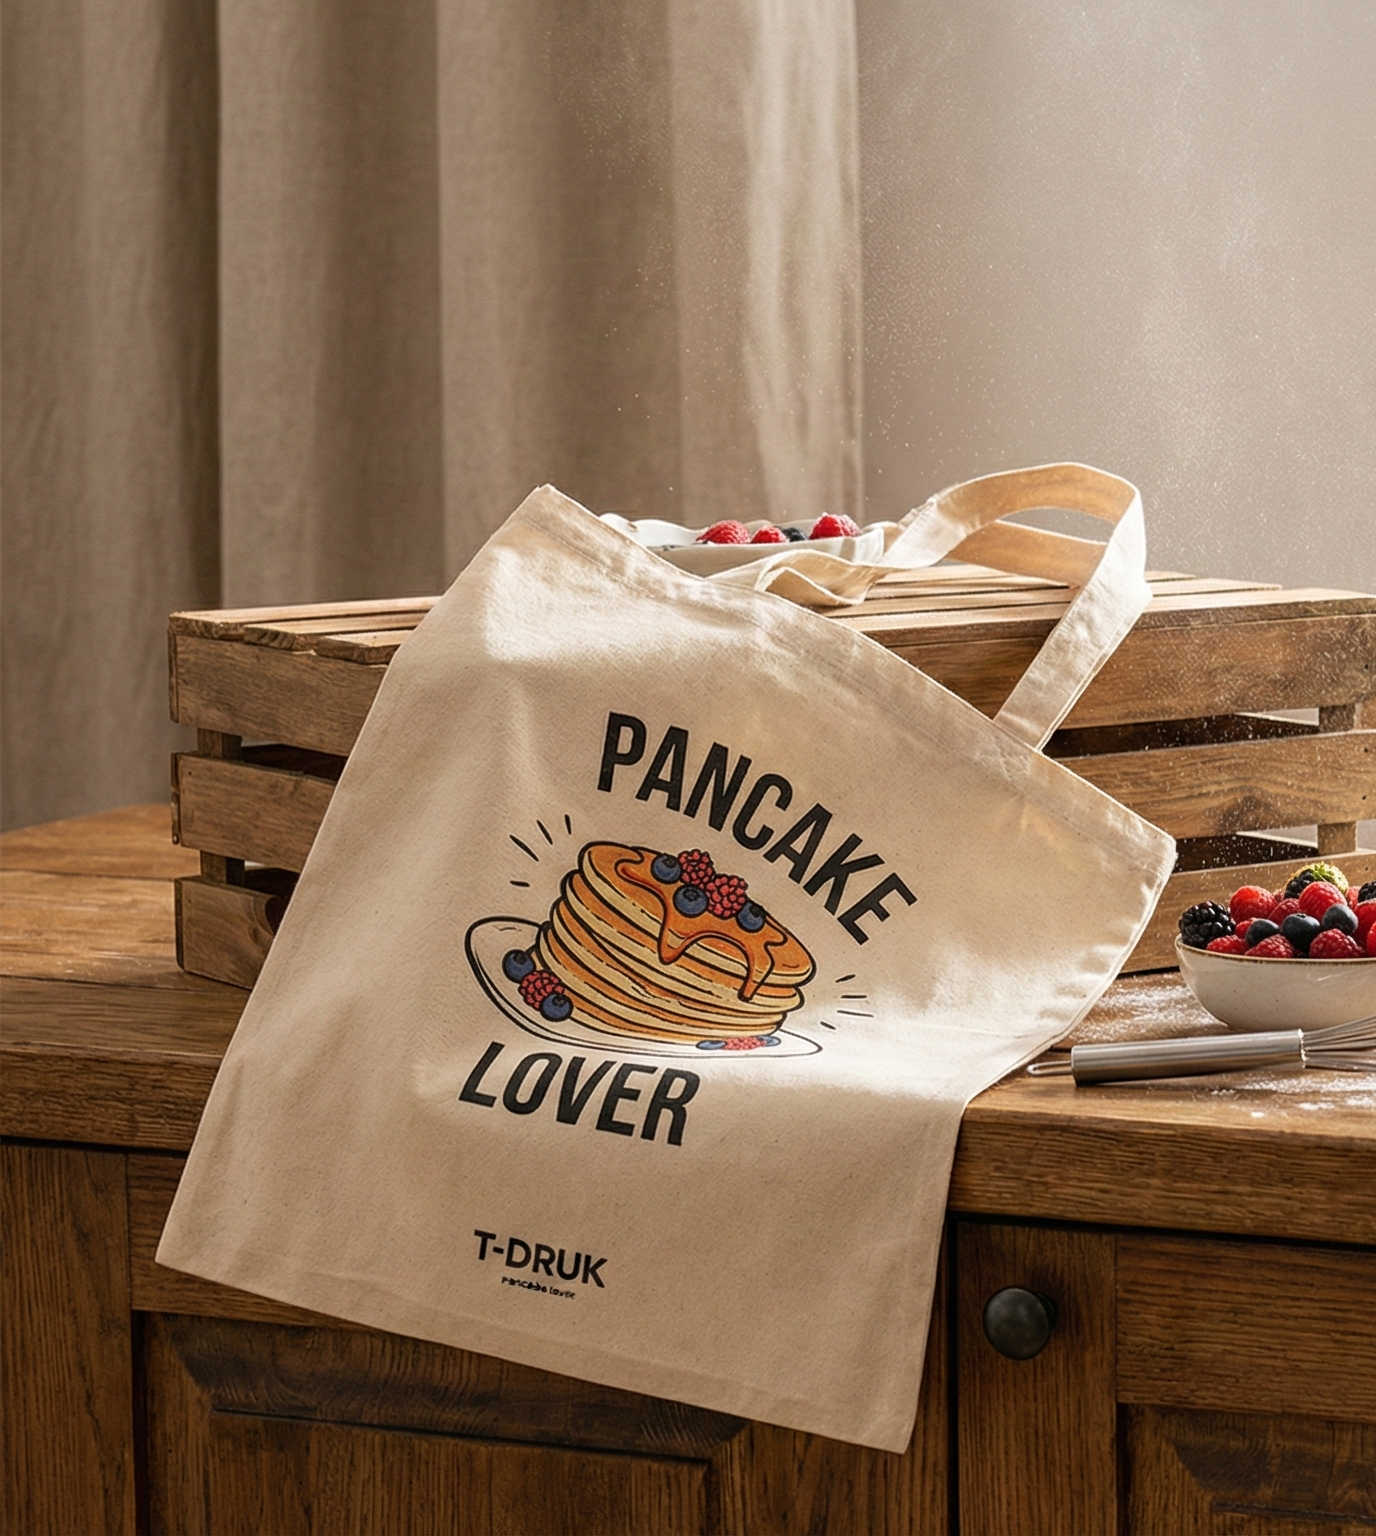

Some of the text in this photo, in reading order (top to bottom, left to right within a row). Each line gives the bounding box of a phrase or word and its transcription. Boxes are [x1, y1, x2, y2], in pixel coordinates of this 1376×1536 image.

[597, 711, 917, 945] PANCAKE
[458, 1041, 700, 1146] LOVER
[474, 1229, 608, 1288] T-DRUK
